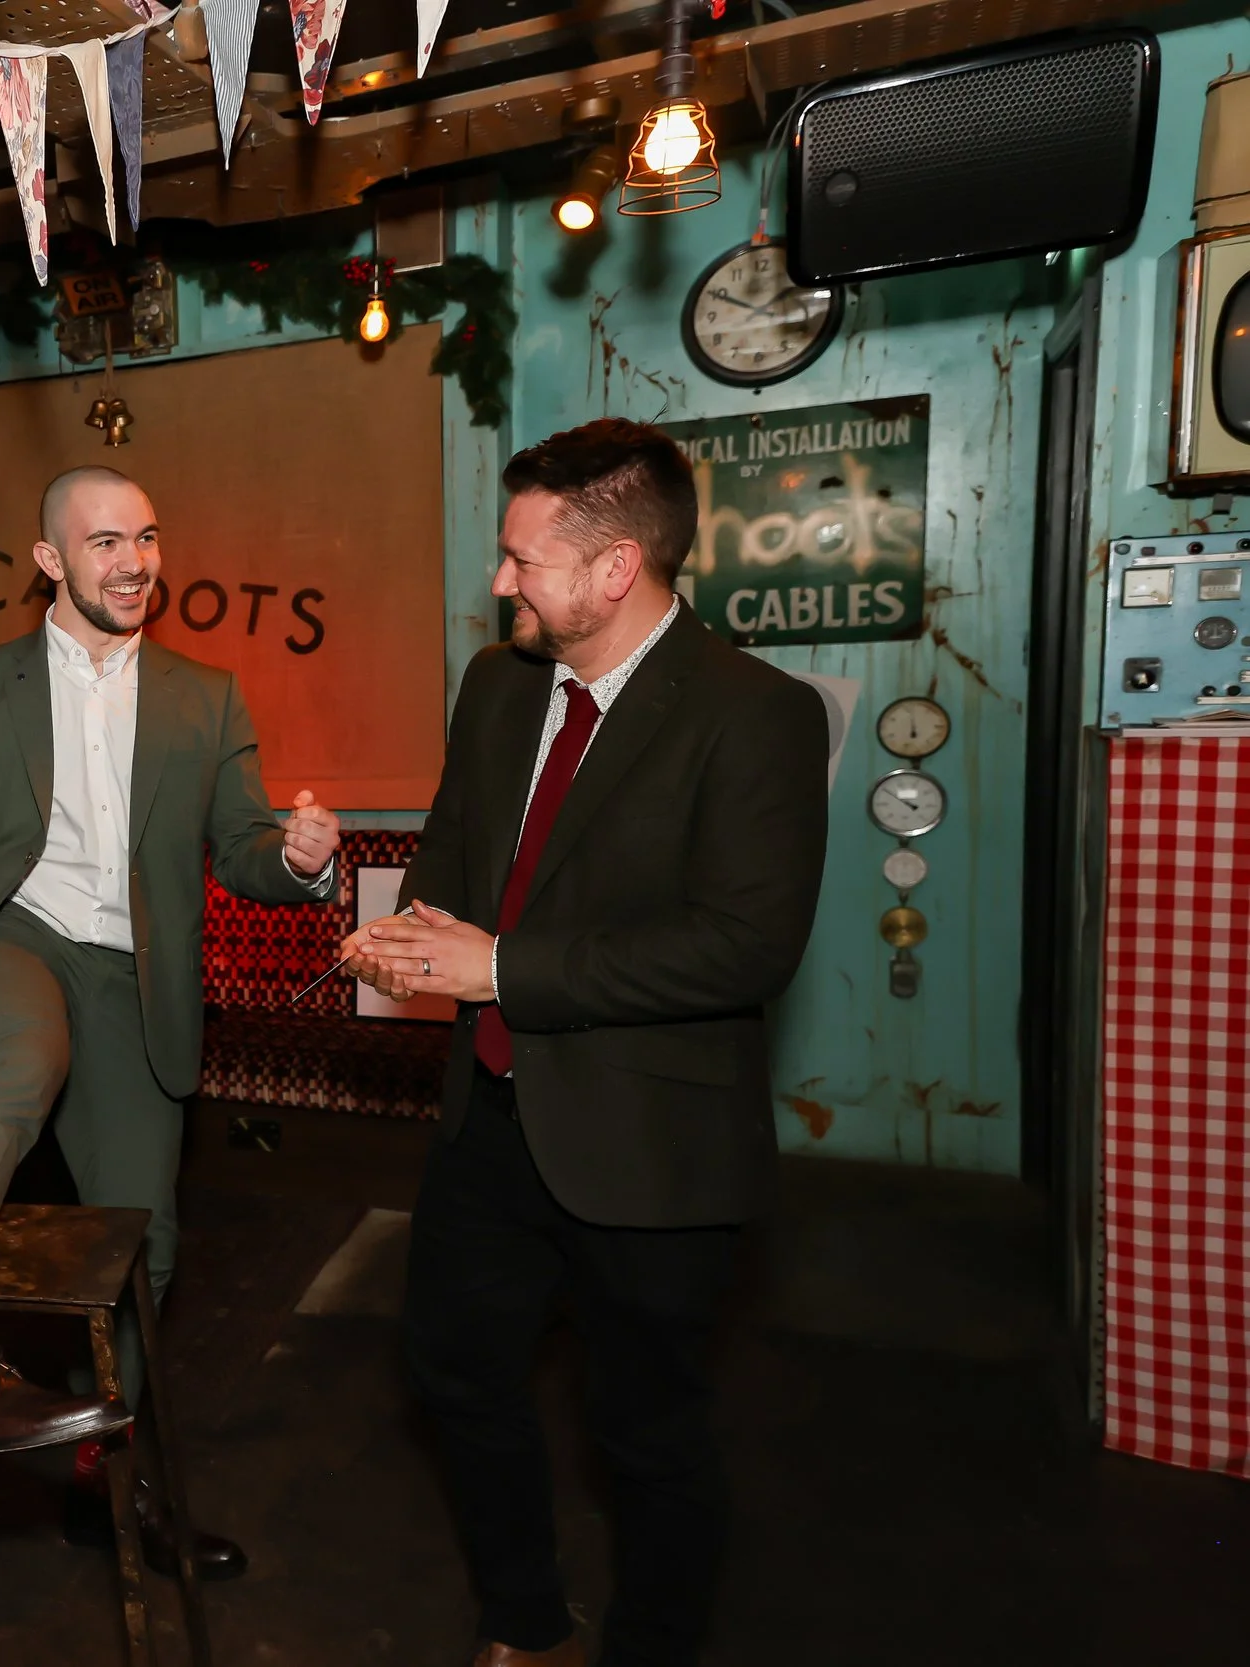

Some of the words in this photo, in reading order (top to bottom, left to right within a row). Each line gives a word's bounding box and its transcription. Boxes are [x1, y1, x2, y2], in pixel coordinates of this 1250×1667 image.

[755, 259, 769, 273] 12
[731, 269, 743, 281] 11
[707, 311, 717, 324] 9
[749, 415, 911, 461] INSTALLATION
[740, 464, 764, 478] BY
[684, 451, 924, 576] hoots
[725, 580, 905, 633] CABLES
